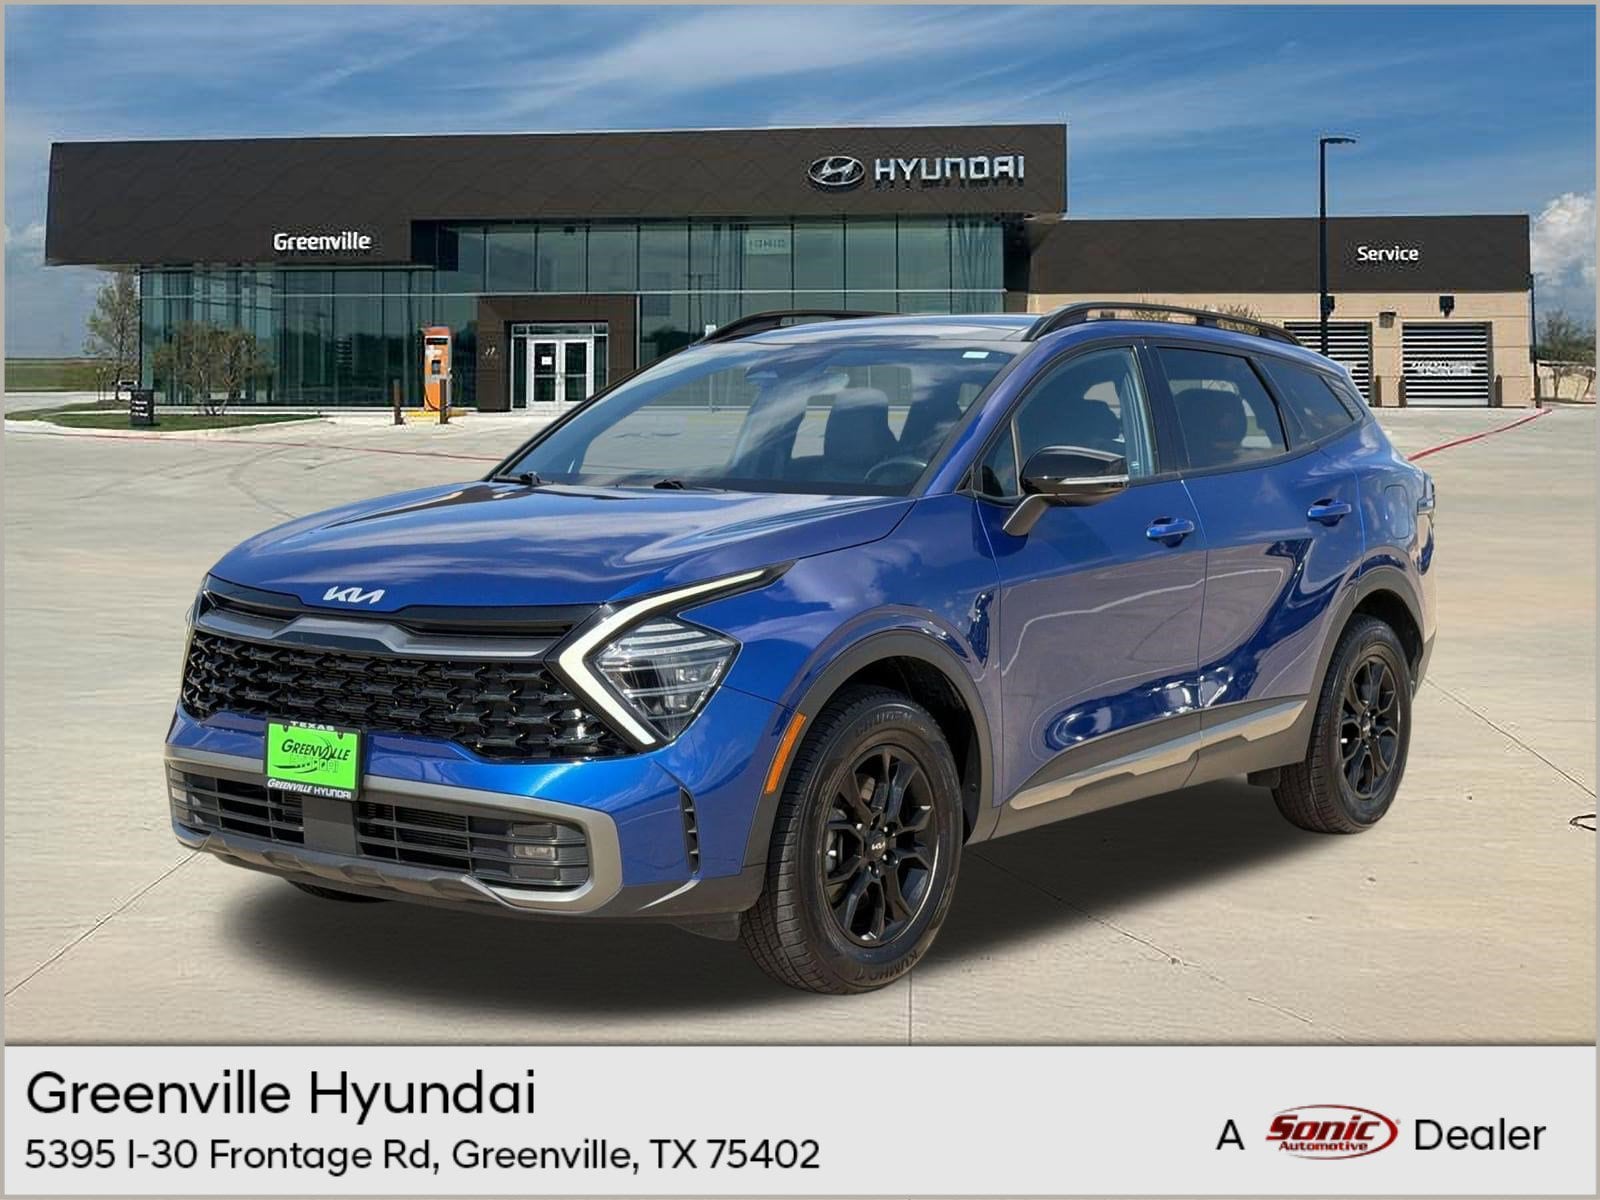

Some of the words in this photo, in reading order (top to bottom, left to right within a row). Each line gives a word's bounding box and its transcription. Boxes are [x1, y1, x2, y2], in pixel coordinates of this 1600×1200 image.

[875, 155, 1025, 181] HYUNDAI
[273, 231, 372, 251] Greenville
[1356, 245, 1420, 262] Service
[322, 585, 386, 605] KIA
[290, 720, 335, 732] TEXAS
[281, 738, 351, 761] GREENVILLE
[267, 778, 313, 794] GREENVILLE
[313, 786, 352, 800] HYUNDAI
